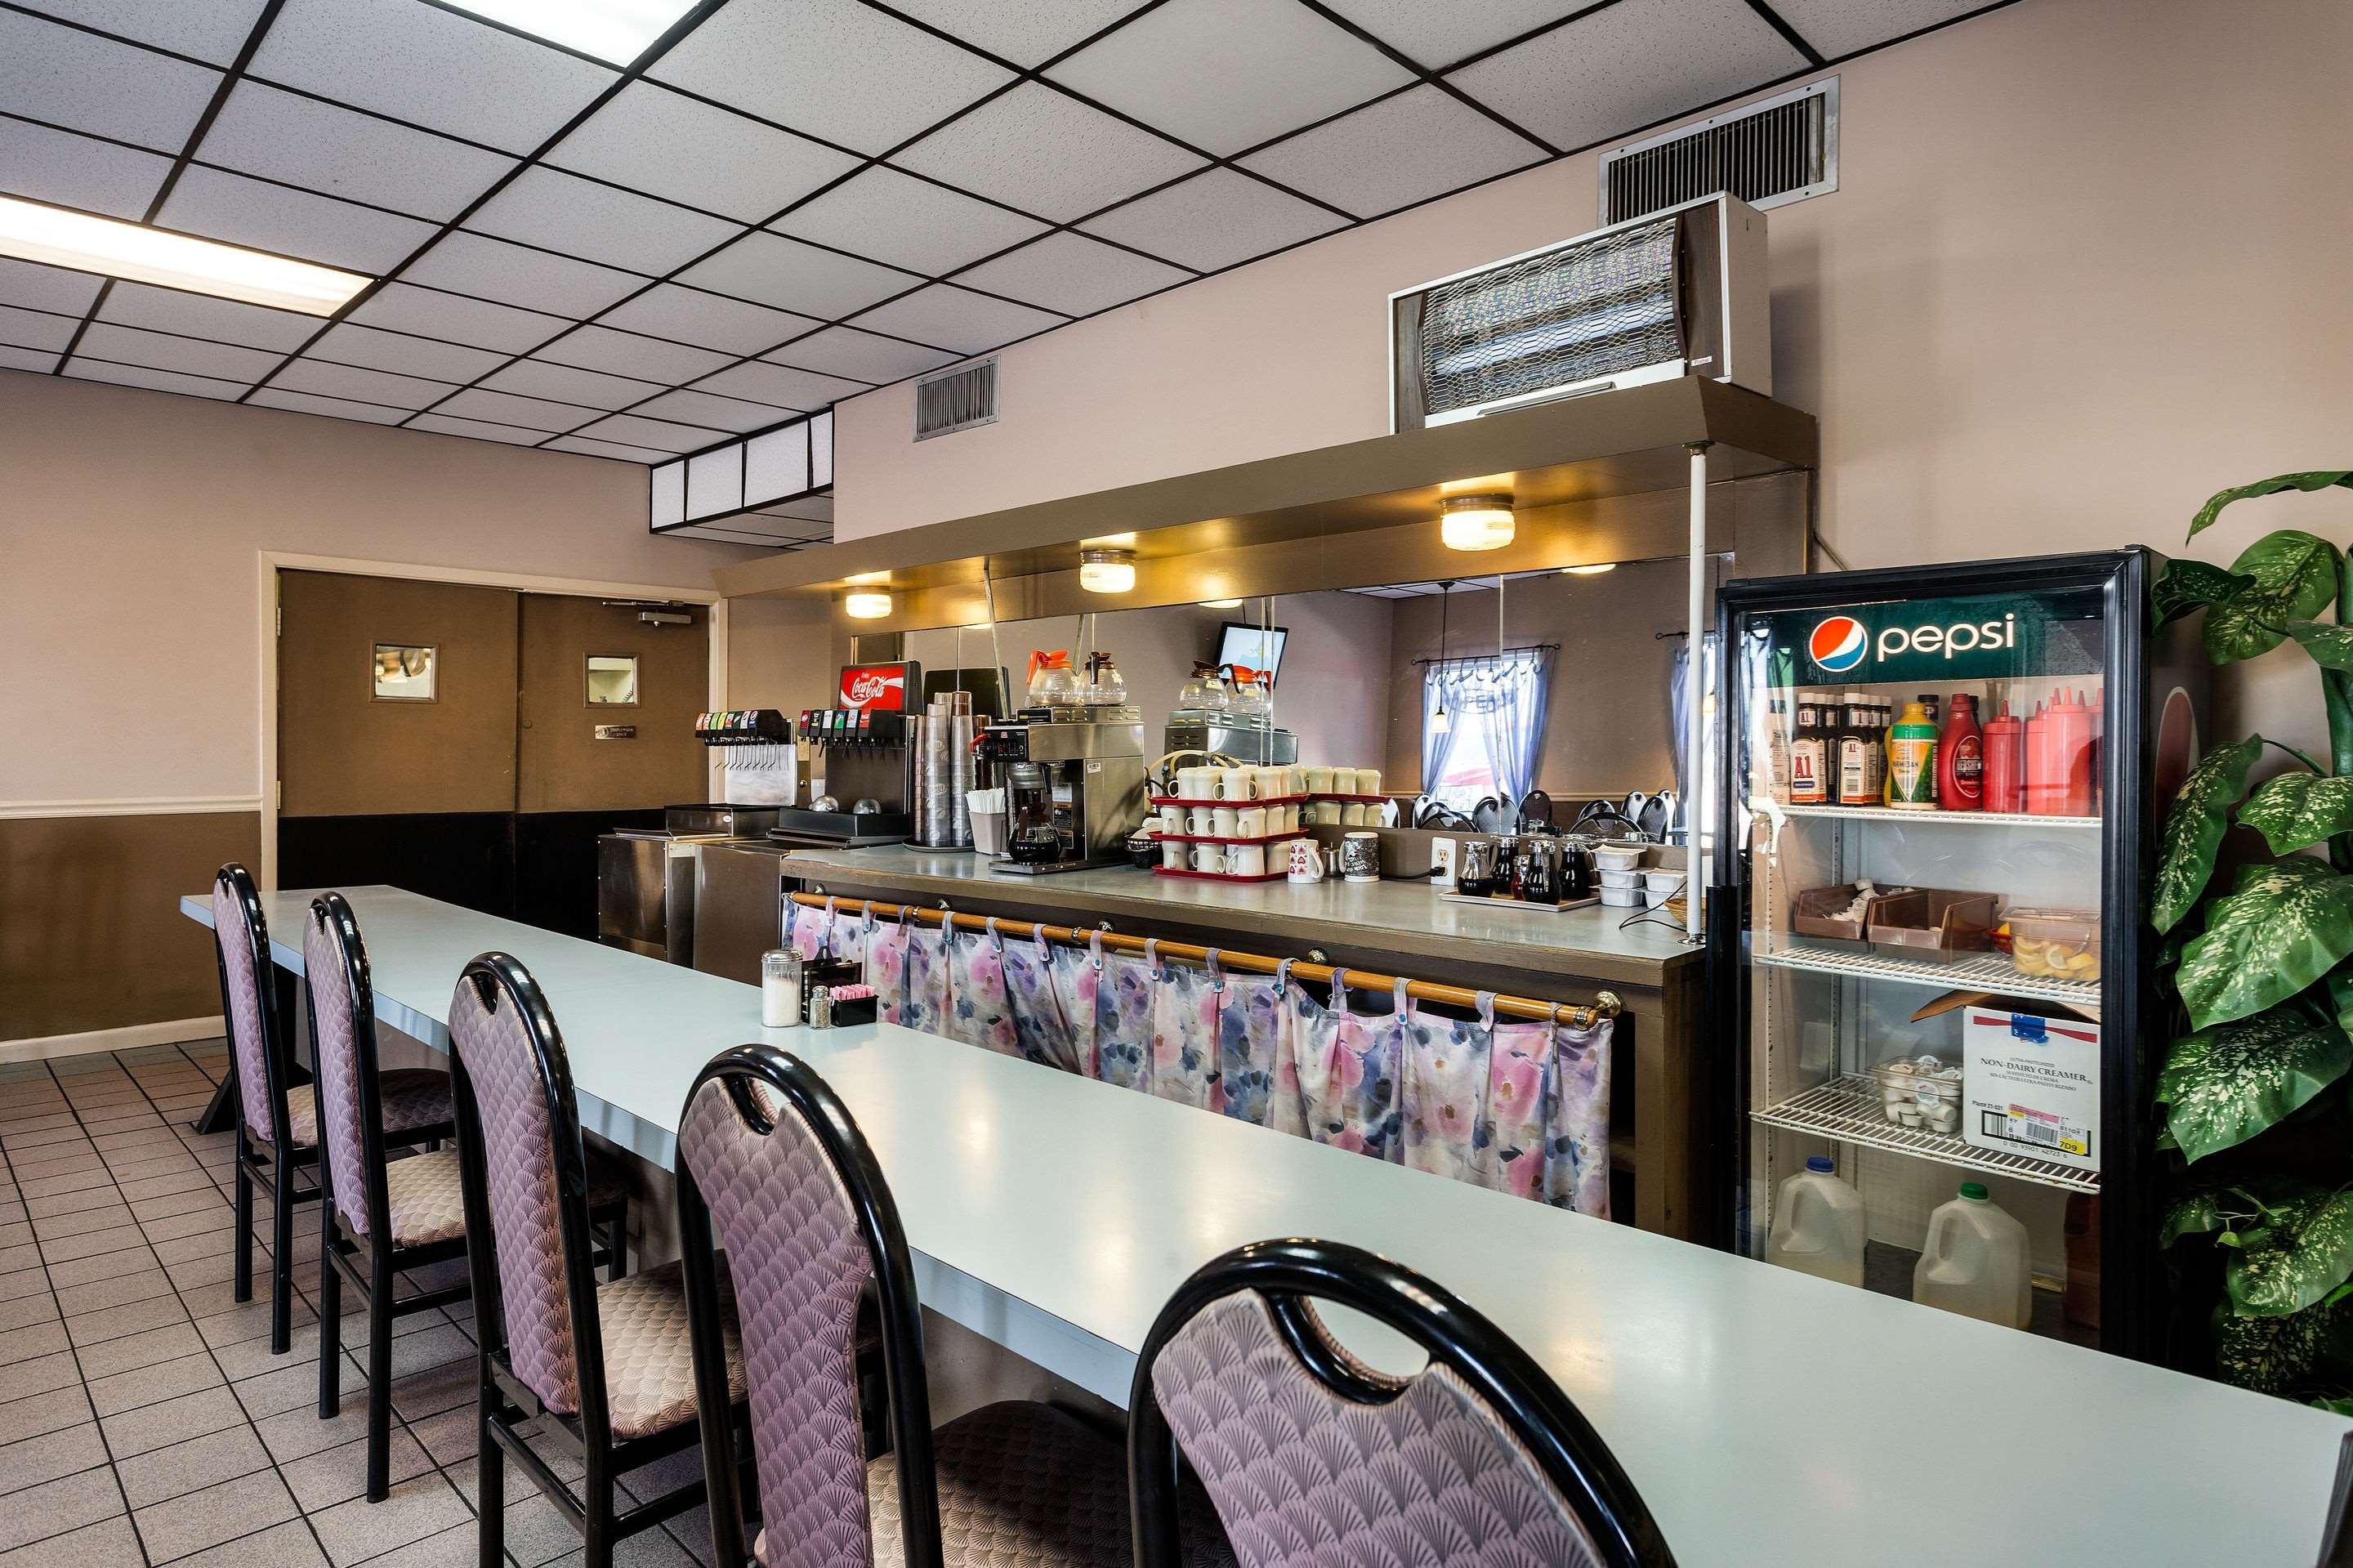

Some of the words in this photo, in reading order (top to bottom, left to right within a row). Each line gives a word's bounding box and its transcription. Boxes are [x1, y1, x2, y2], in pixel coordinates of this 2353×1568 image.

[1877, 613, 2015, 662] pepsi
[851, 676, 887, 699] Coca-Cola
[1980, 1057, 2038, 1074] NON-DAIRY
[2038, 1067, 2087, 1082] CREAMER
[2060, 1141, 2078, 1151] 7D9
